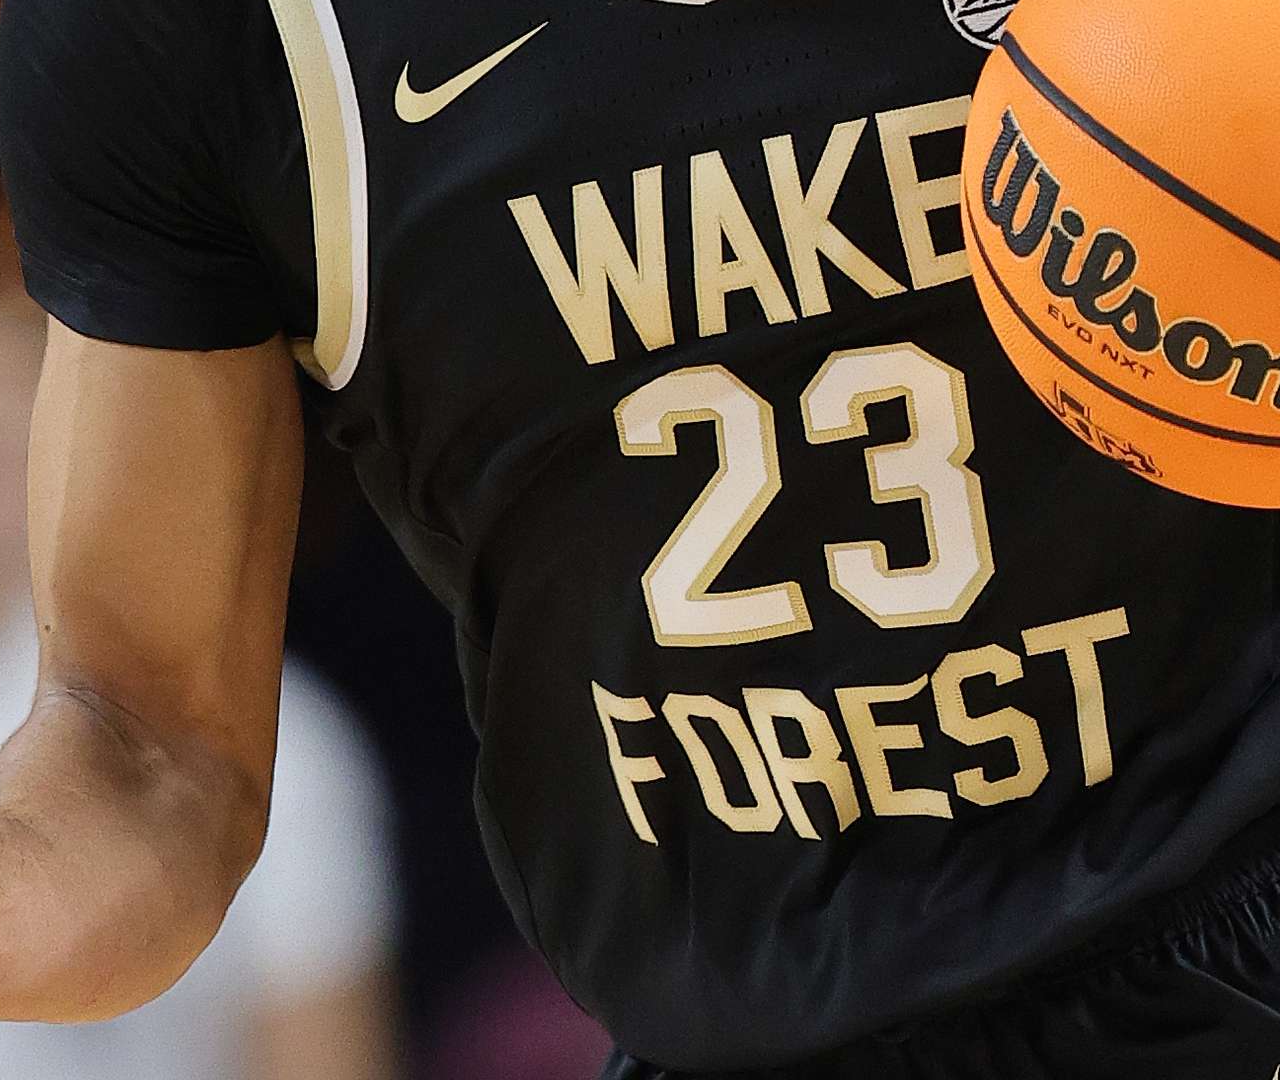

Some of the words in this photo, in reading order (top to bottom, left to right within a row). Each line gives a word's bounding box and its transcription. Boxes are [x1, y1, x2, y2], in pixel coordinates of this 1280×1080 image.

[507, 94, 973, 365] WAKE
[1047, 302, 1094, 345] EVO
[1100, 343, 1155, 380] NXT
[613, 341, 995, 647] 23
[591, 606, 1131, 846] FOREST
